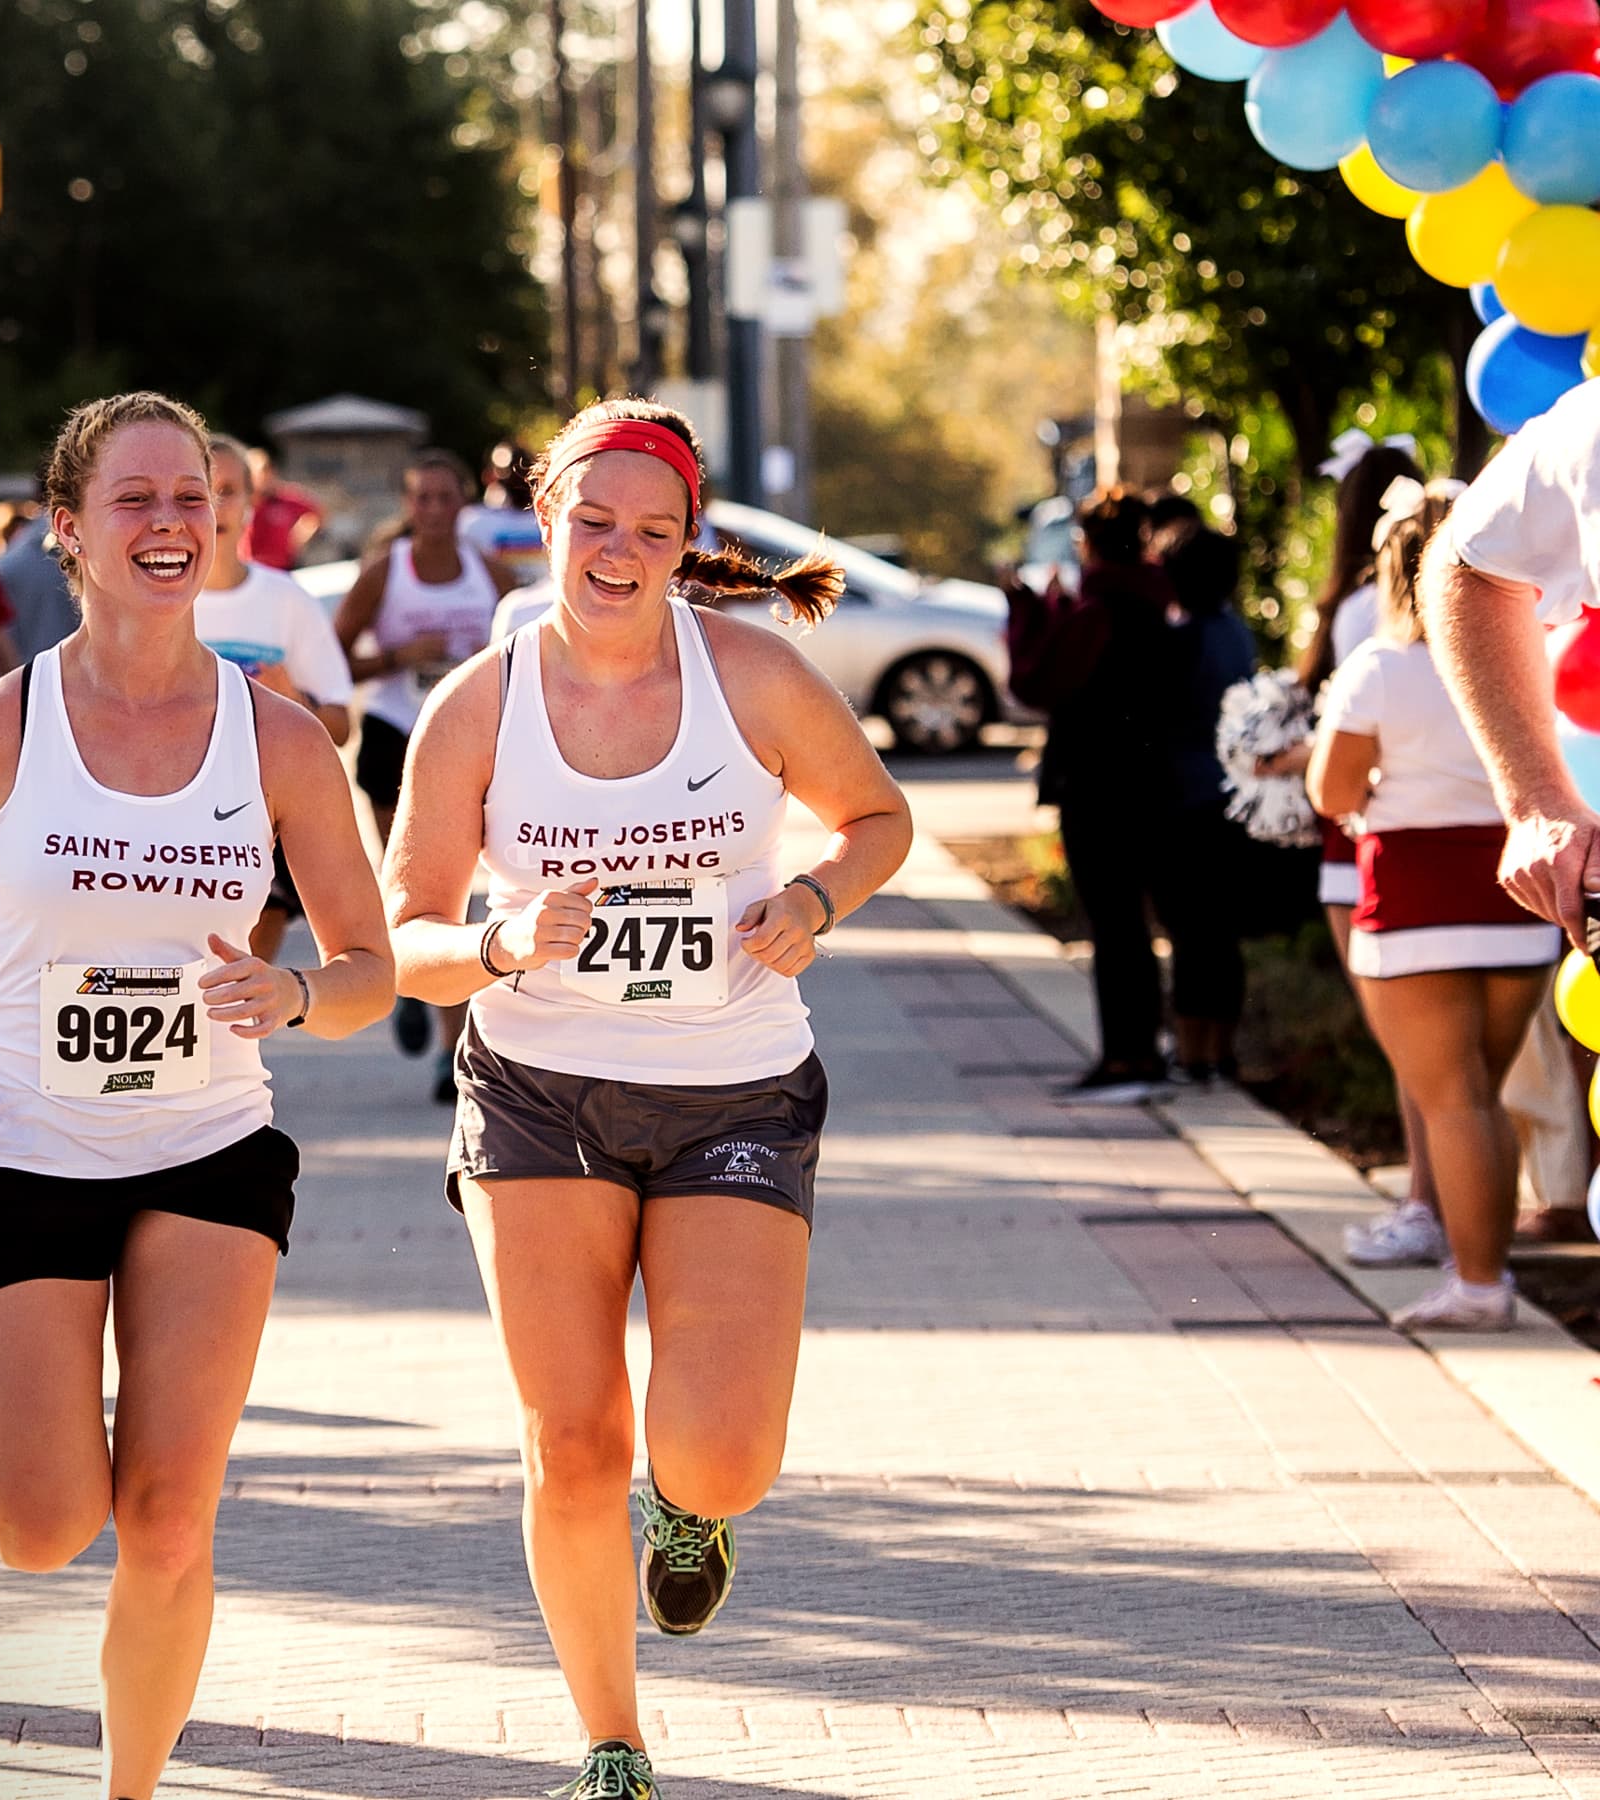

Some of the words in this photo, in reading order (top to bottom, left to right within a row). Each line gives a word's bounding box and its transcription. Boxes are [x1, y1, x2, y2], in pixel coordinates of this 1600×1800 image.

[517, 822, 600, 849] SAINT
[613, 811, 746, 846] JOSEPH'S
[44, 833, 130, 861] SAINT
[142, 843, 262, 869] JOSEPH'S
[541, 850, 721, 878] ROWING
[72, 869, 245, 901] ROWING
[577, 916, 714, 973] 2475
[631, 983, 669, 993] NOLAN
[57, 1003, 199, 1064] 9924
[112, 1073, 152, 1084] NOLAN
[704, 1141, 780, 1161] ARCHMERE
[709, 1173, 778, 1188] BASKETBALL
